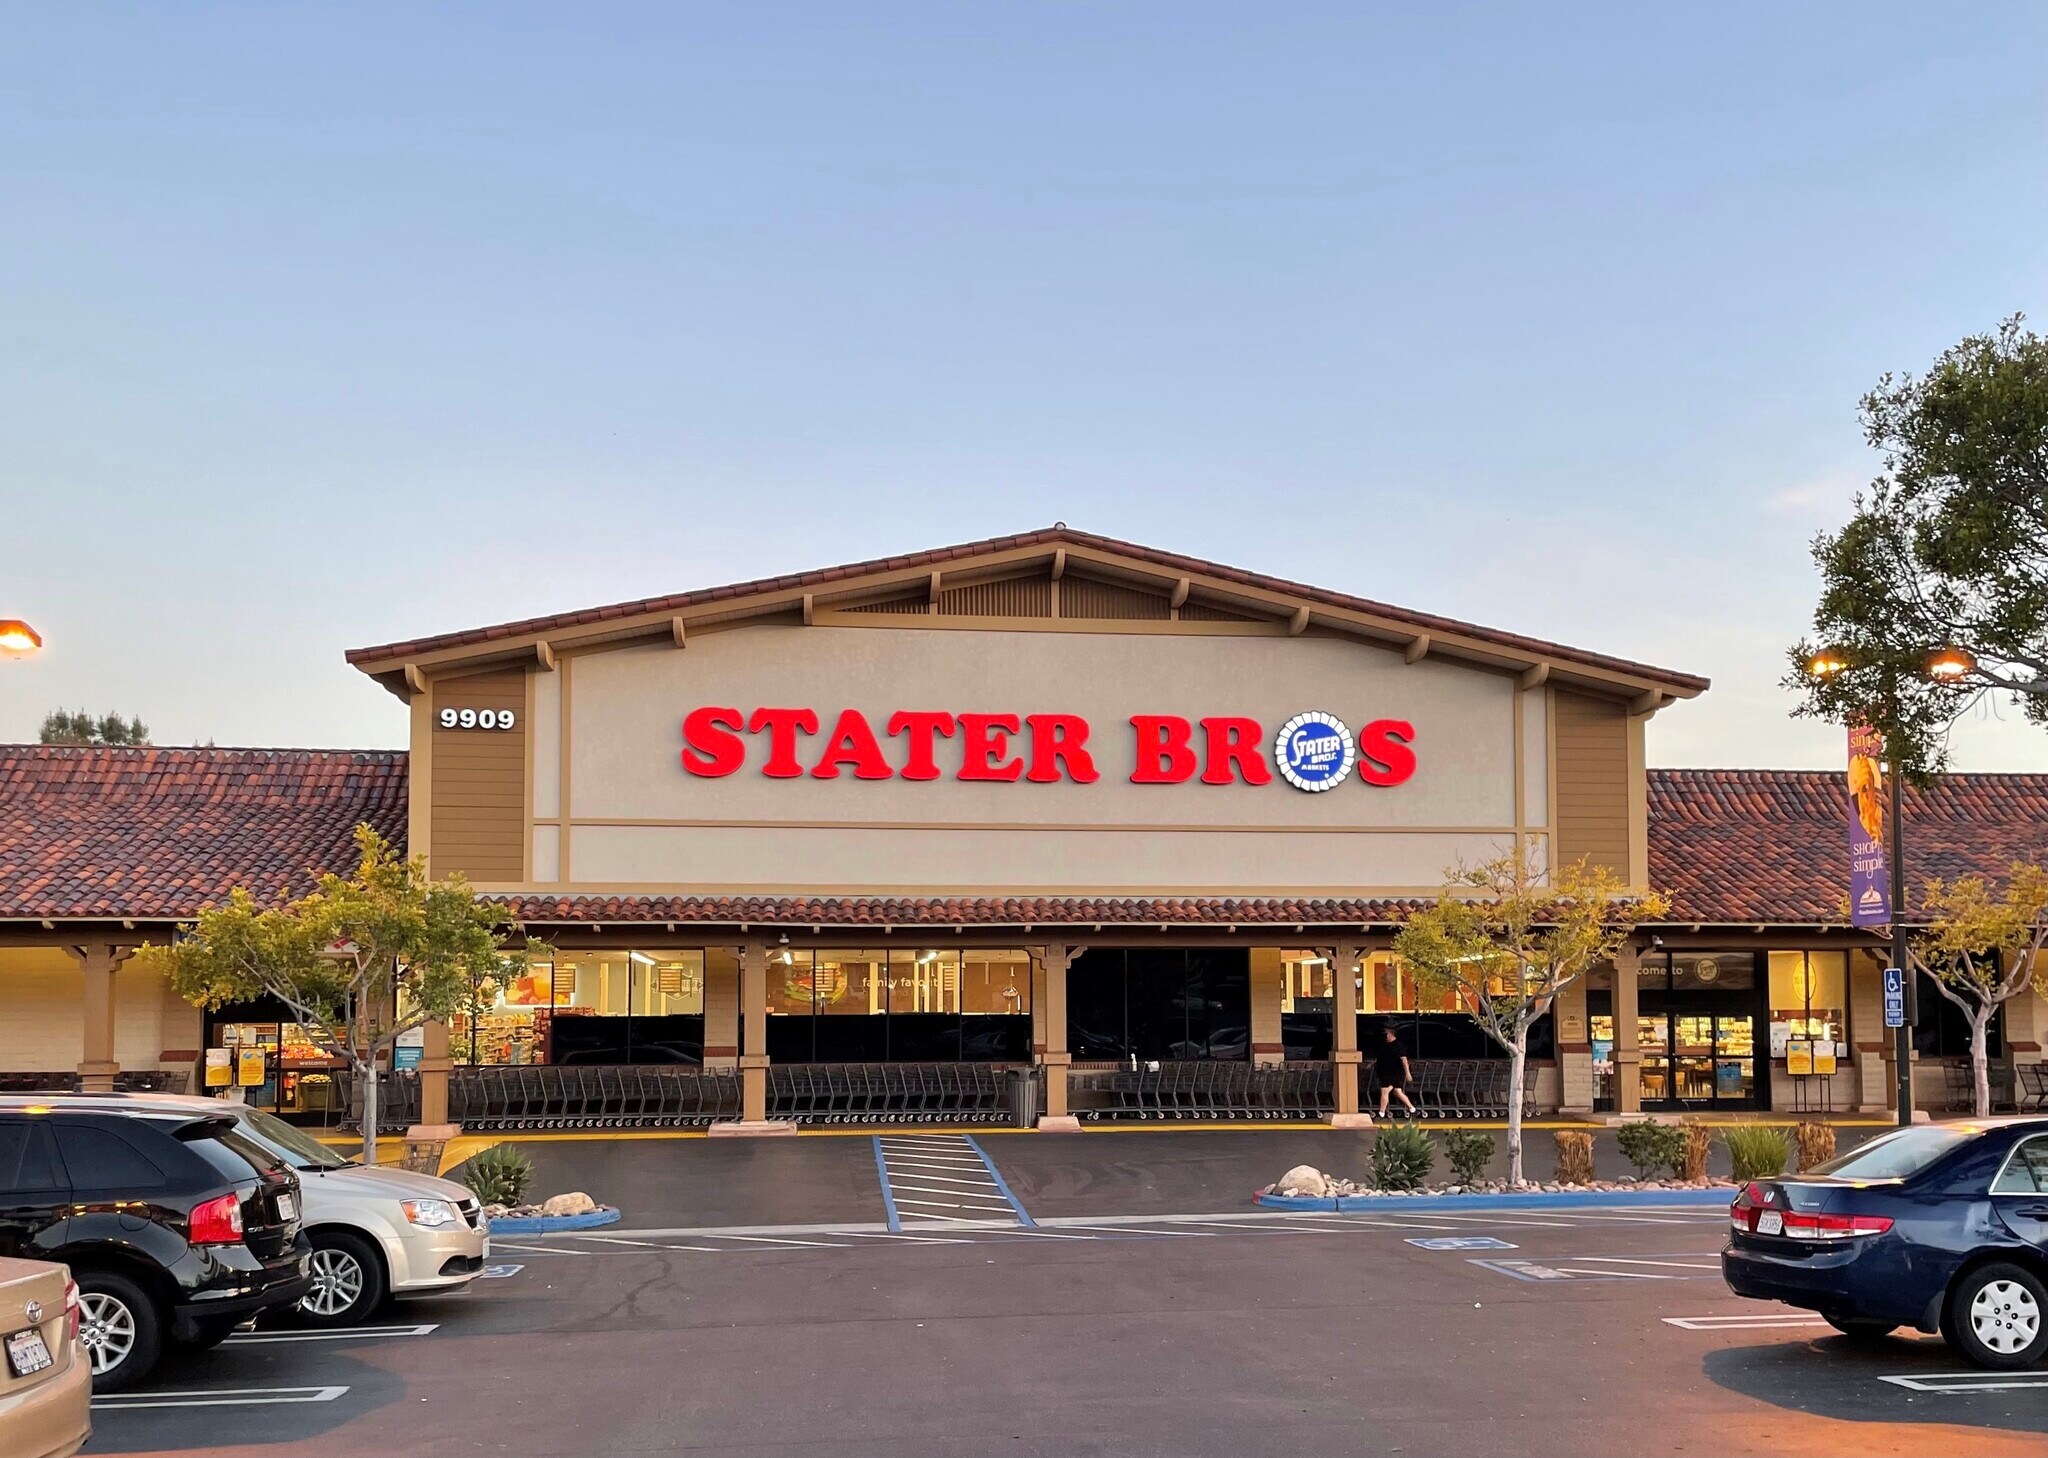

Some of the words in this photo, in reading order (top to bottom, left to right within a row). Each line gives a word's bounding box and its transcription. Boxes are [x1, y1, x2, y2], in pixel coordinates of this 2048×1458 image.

[440, 708, 515, 729] 9909
[682, 707, 1100, 784] STATER
[1290, 730, 1340, 767] STATER
[1853, 842, 1877, 856] SHOP
[1853, 848, 1884, 879] simple
[1672, 966, 1684, 975] to
